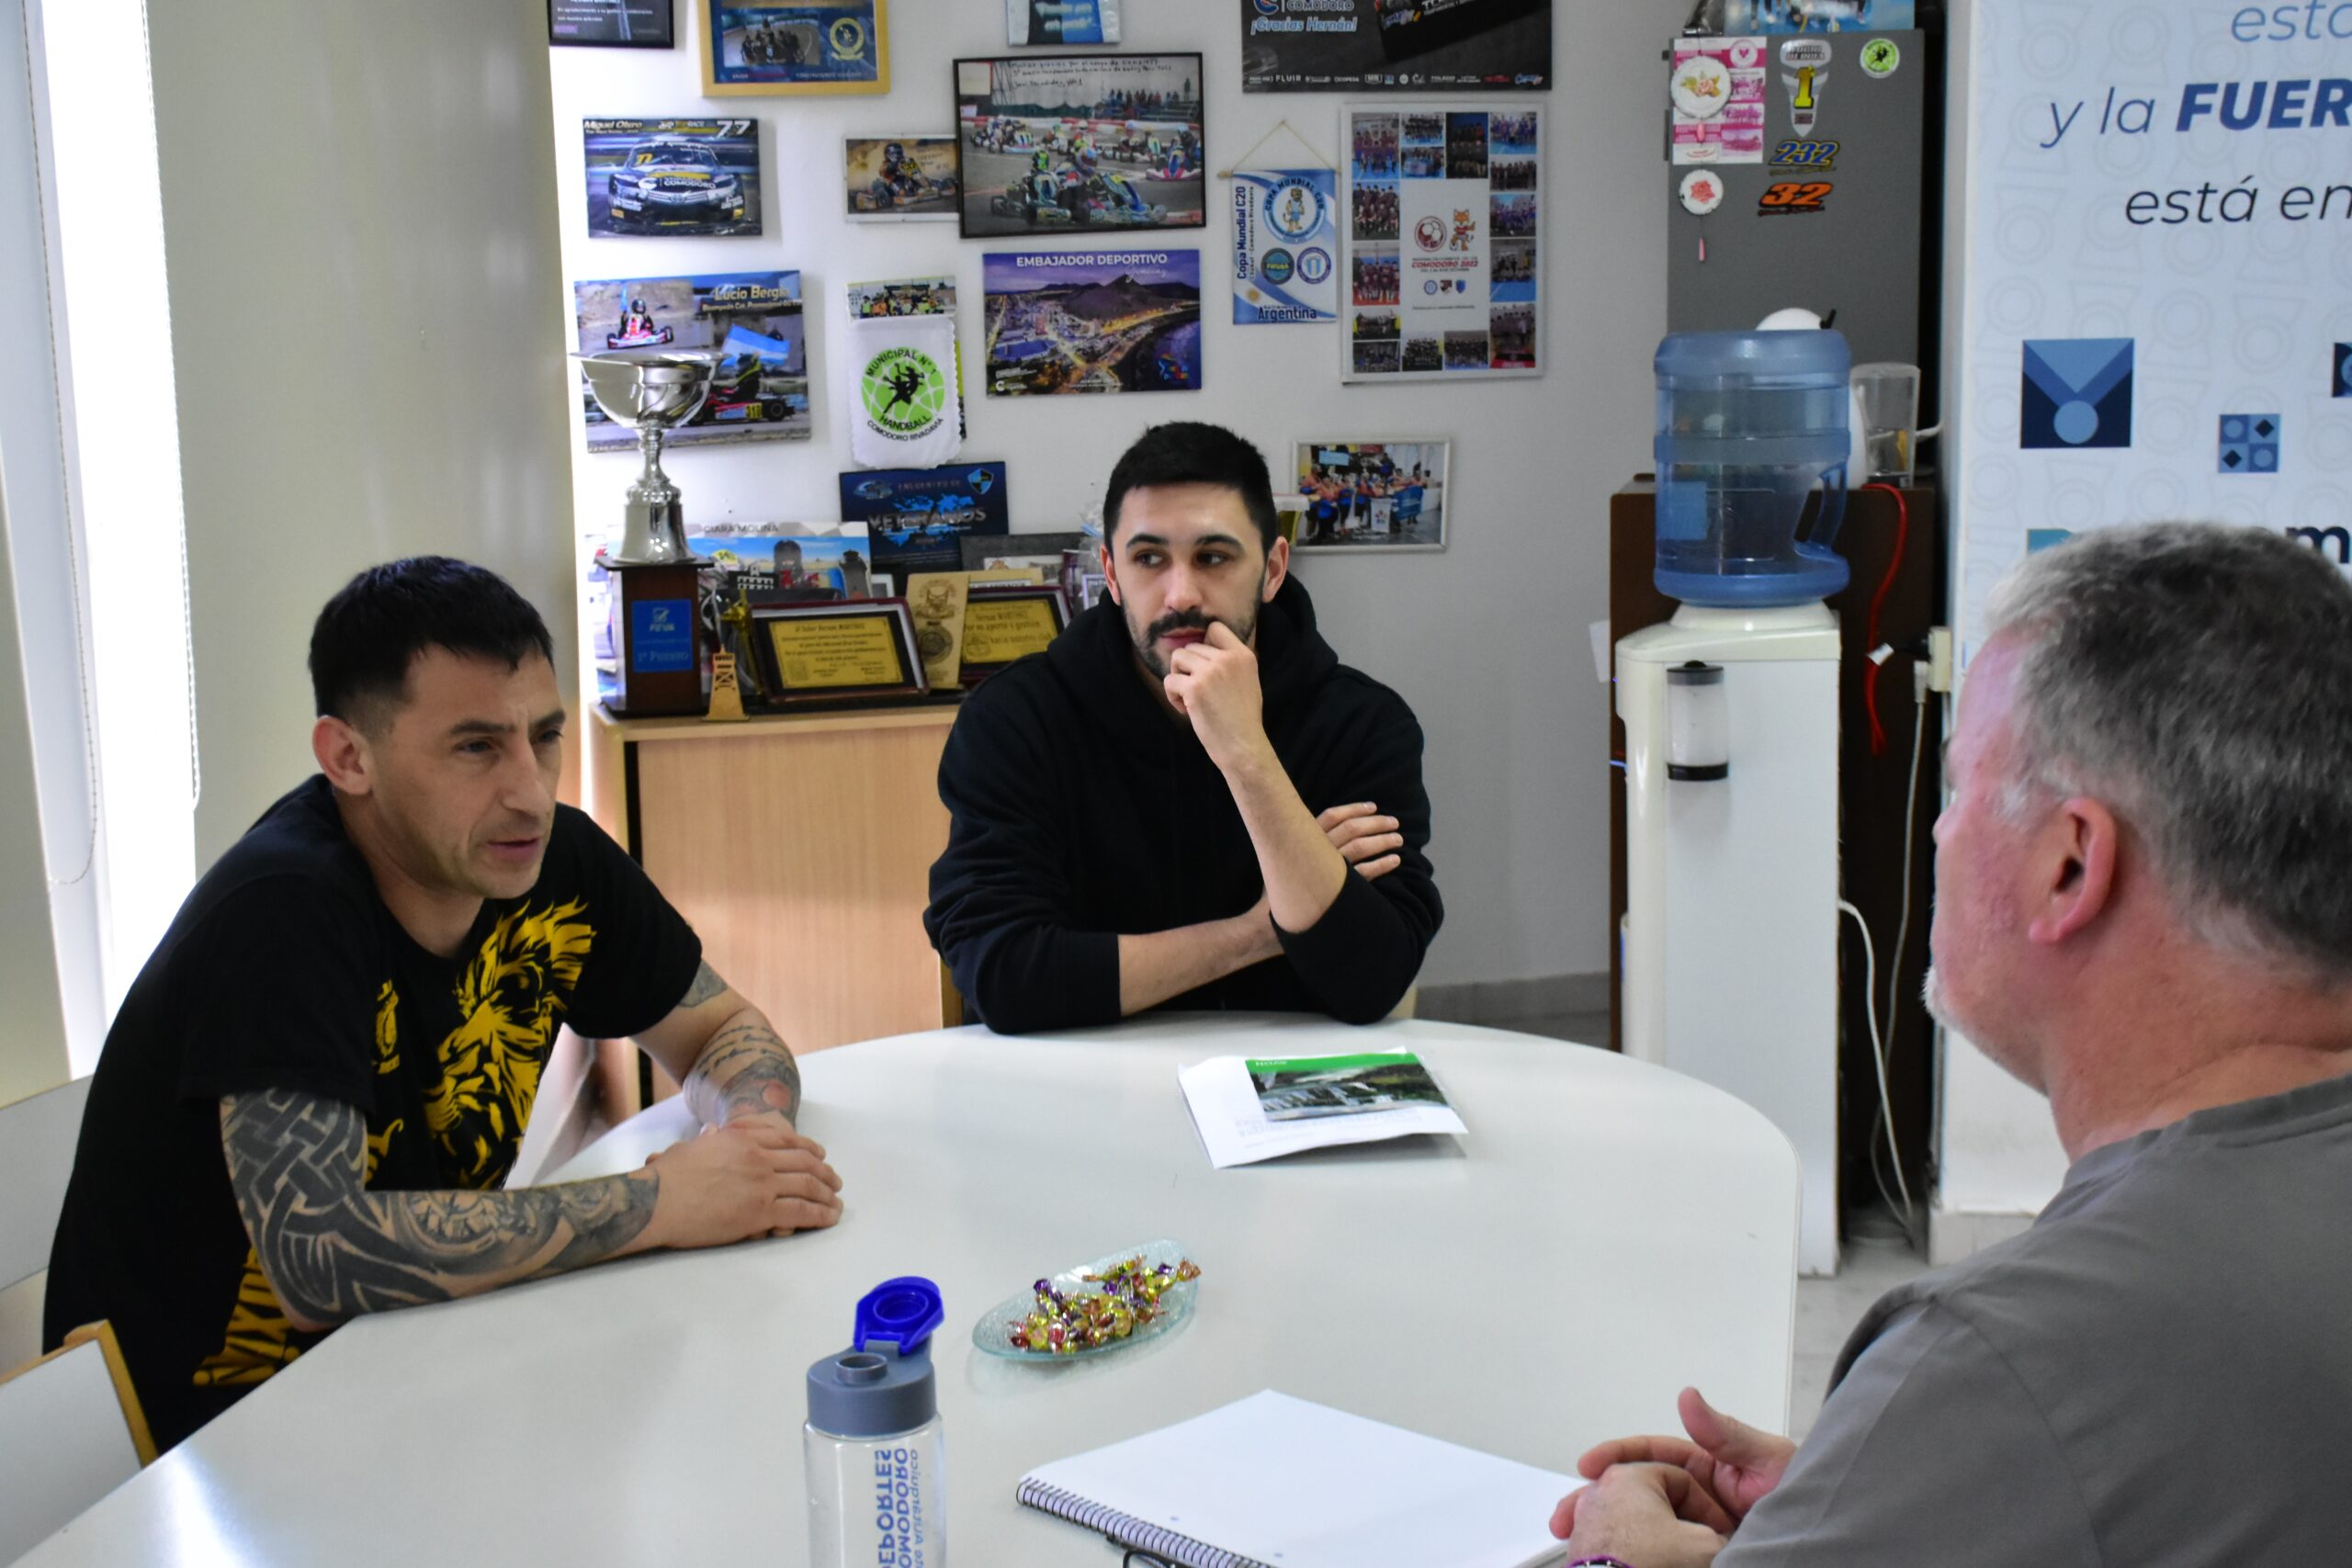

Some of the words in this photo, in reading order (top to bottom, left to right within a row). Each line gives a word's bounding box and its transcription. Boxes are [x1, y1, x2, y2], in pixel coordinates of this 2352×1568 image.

[2040, 101, 2084, 149] y
[2100, 86, 2155, 135] la
[714, 120, 751, 139] 77
[1770, 140, 1839, 166] 232
[1278, 177, 1315, 191] MUNDIAL
[1760, 182, 1832, 206] 32
[1236, 186, 1246, 207] C20
[2125, 175, 2258, 225] está
[2279, 184, 2352, 221] en
[1236, 209, 1247, 250] Mundial
[1016, 255, 1094, 267] EMBAJADOR
[1097, 254, 1168, 265] DEPORTIVO
[1237, 254, 1250, 279] Copa
[715, 286, 748, 300] Lucio
[1258, 307, 1317, 322] Argentina
[865, 349, 918, 377] MUNICIPAL
[866, 419, 909, 441] COMODORO
[910, 418, 944, 441] RIVADAVIA
[878, 414, 932, 431] HANDBALL
[867, 508, 987, 530] VETERANOS
